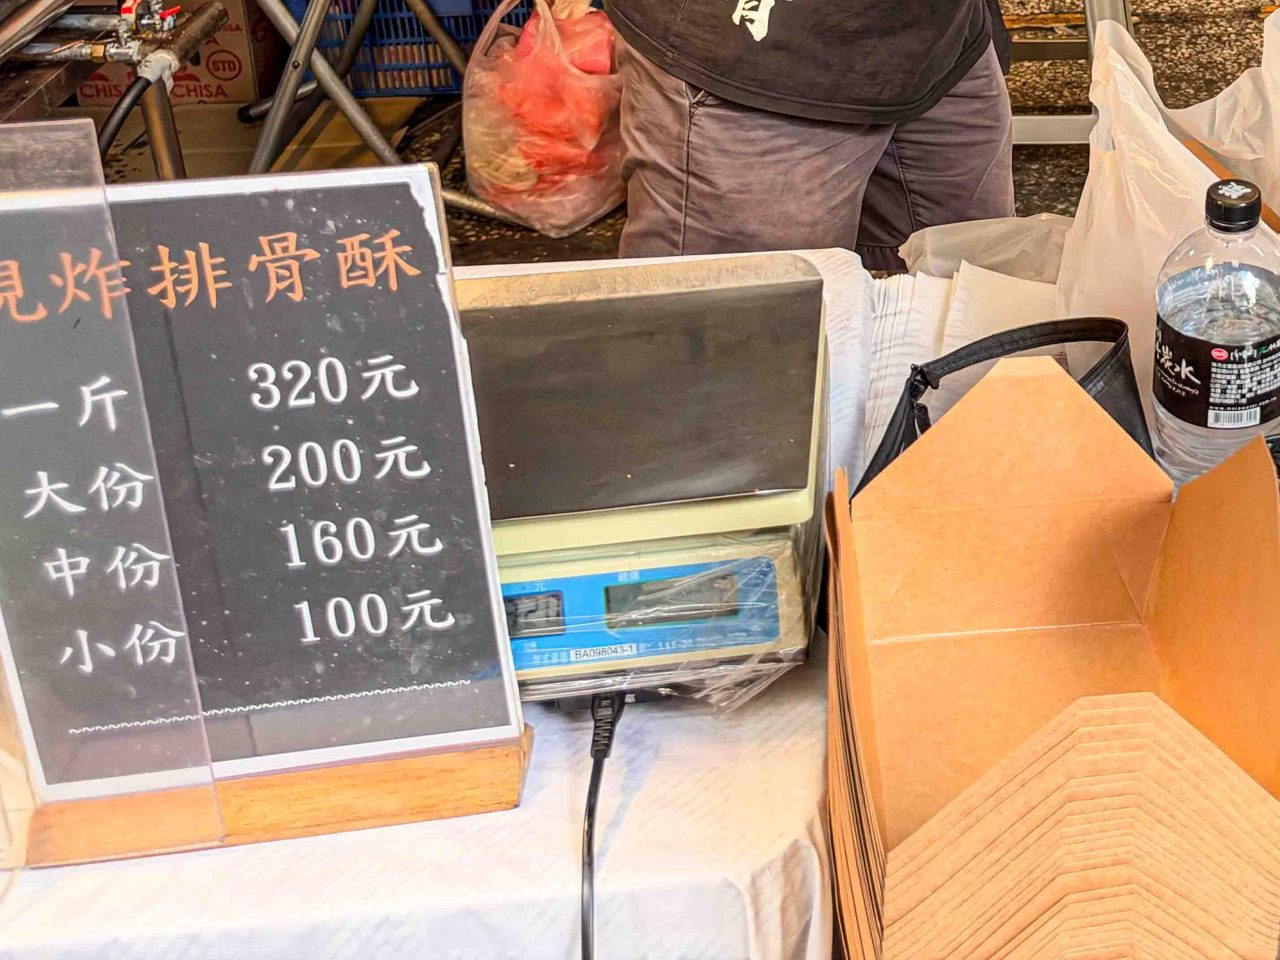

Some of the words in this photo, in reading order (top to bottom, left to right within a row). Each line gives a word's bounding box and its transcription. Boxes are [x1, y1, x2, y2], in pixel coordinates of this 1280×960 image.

[79, 84, 122, 98] CHIS
[171, 84, 228, 98] CHISA
[1, 375, 129, 431] 一斤
[247, 353, 420, 411] 320元
[23, 462, 154, 519] 大份
[262, 435, 432, 492] 200元
[44, 542, 172, 599] 中份
[279, 513, 444, 570] 160元
[58, 622, 188, 675] 小份
[293, 588, 456, 645] 100元
[574, 645, 634, 660] BA098043-1
